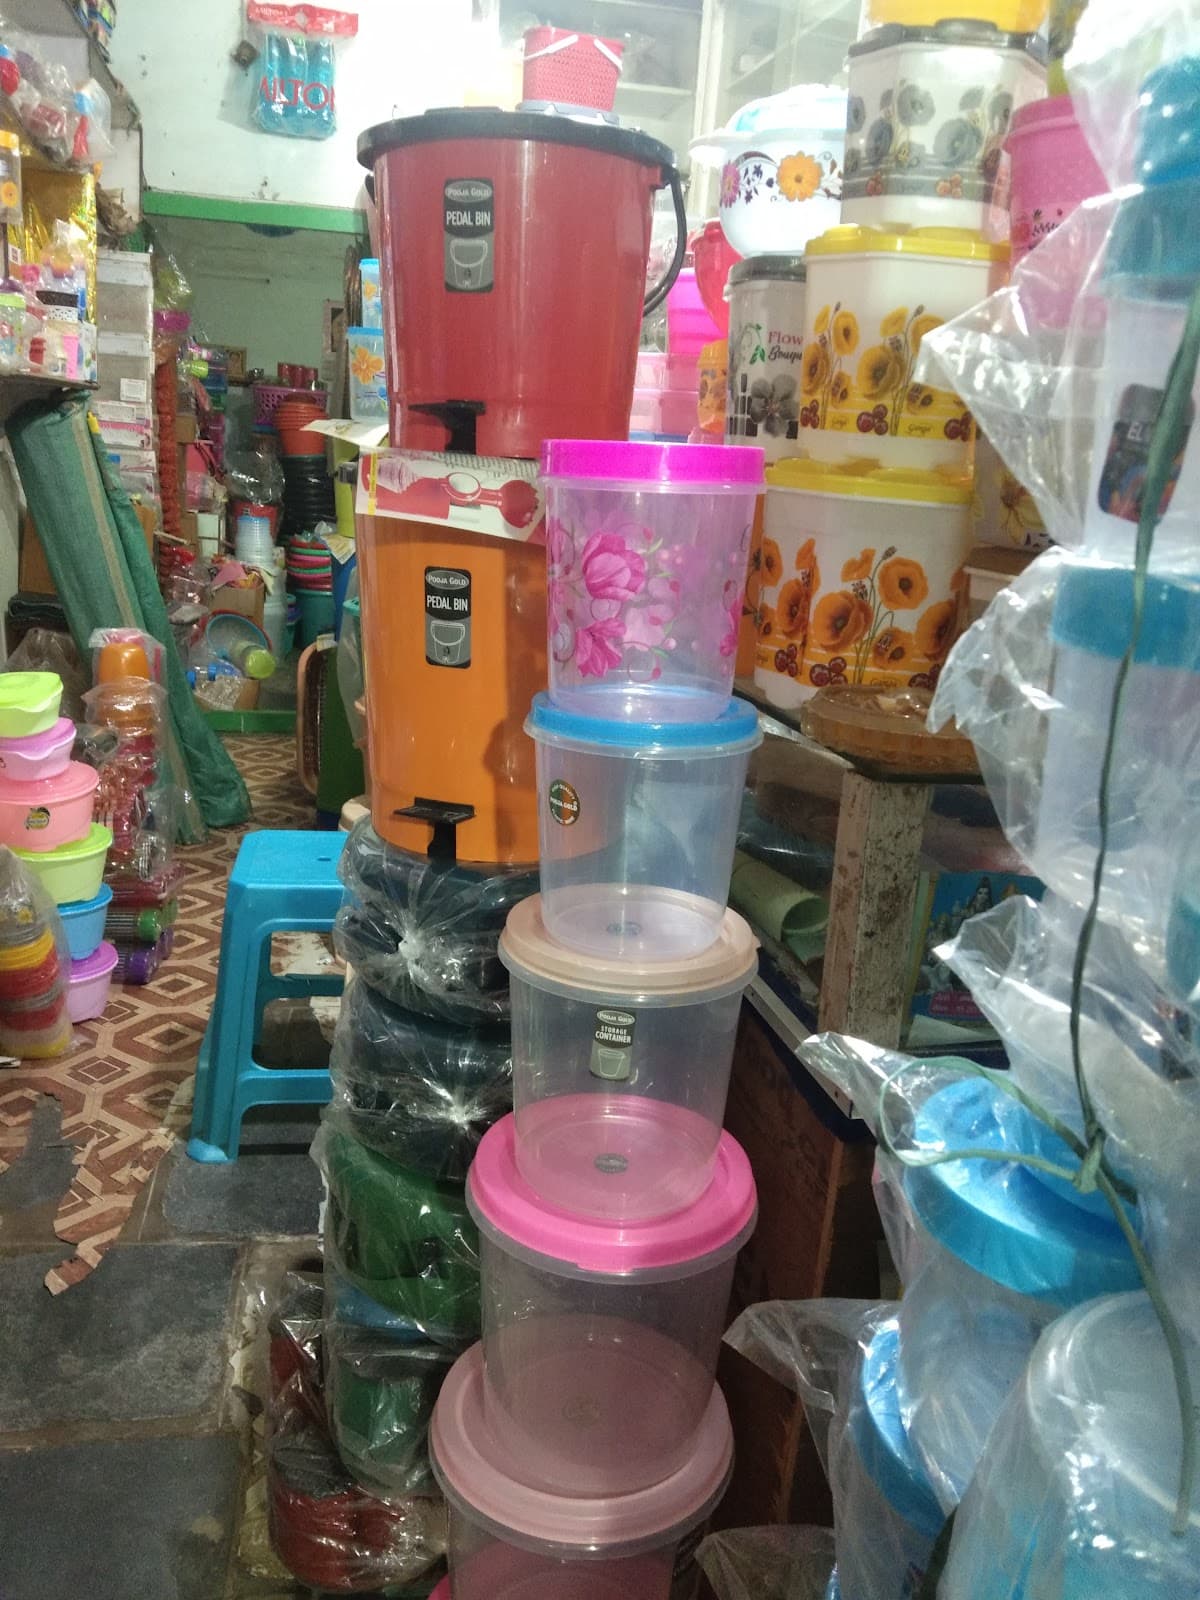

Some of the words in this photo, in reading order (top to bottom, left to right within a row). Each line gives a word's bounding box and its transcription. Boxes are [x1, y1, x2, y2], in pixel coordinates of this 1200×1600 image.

[446, 210, 473, 226] PEDAL
[475, 210, 491, 226] BIN
[768, 330, 803, 345] Flow
[767, 345, 803, 364] Bouqu
[428, 575, 448, 585] POOJA
[449, 576, 467, 587] GOLD
[426, 594, 452, 611] PEDAL
[453, 598, 468, 612] BIN
[595, 1031, 632, 1044] CONTAINER
[601, 1025, 628, 1036] STORAGE
